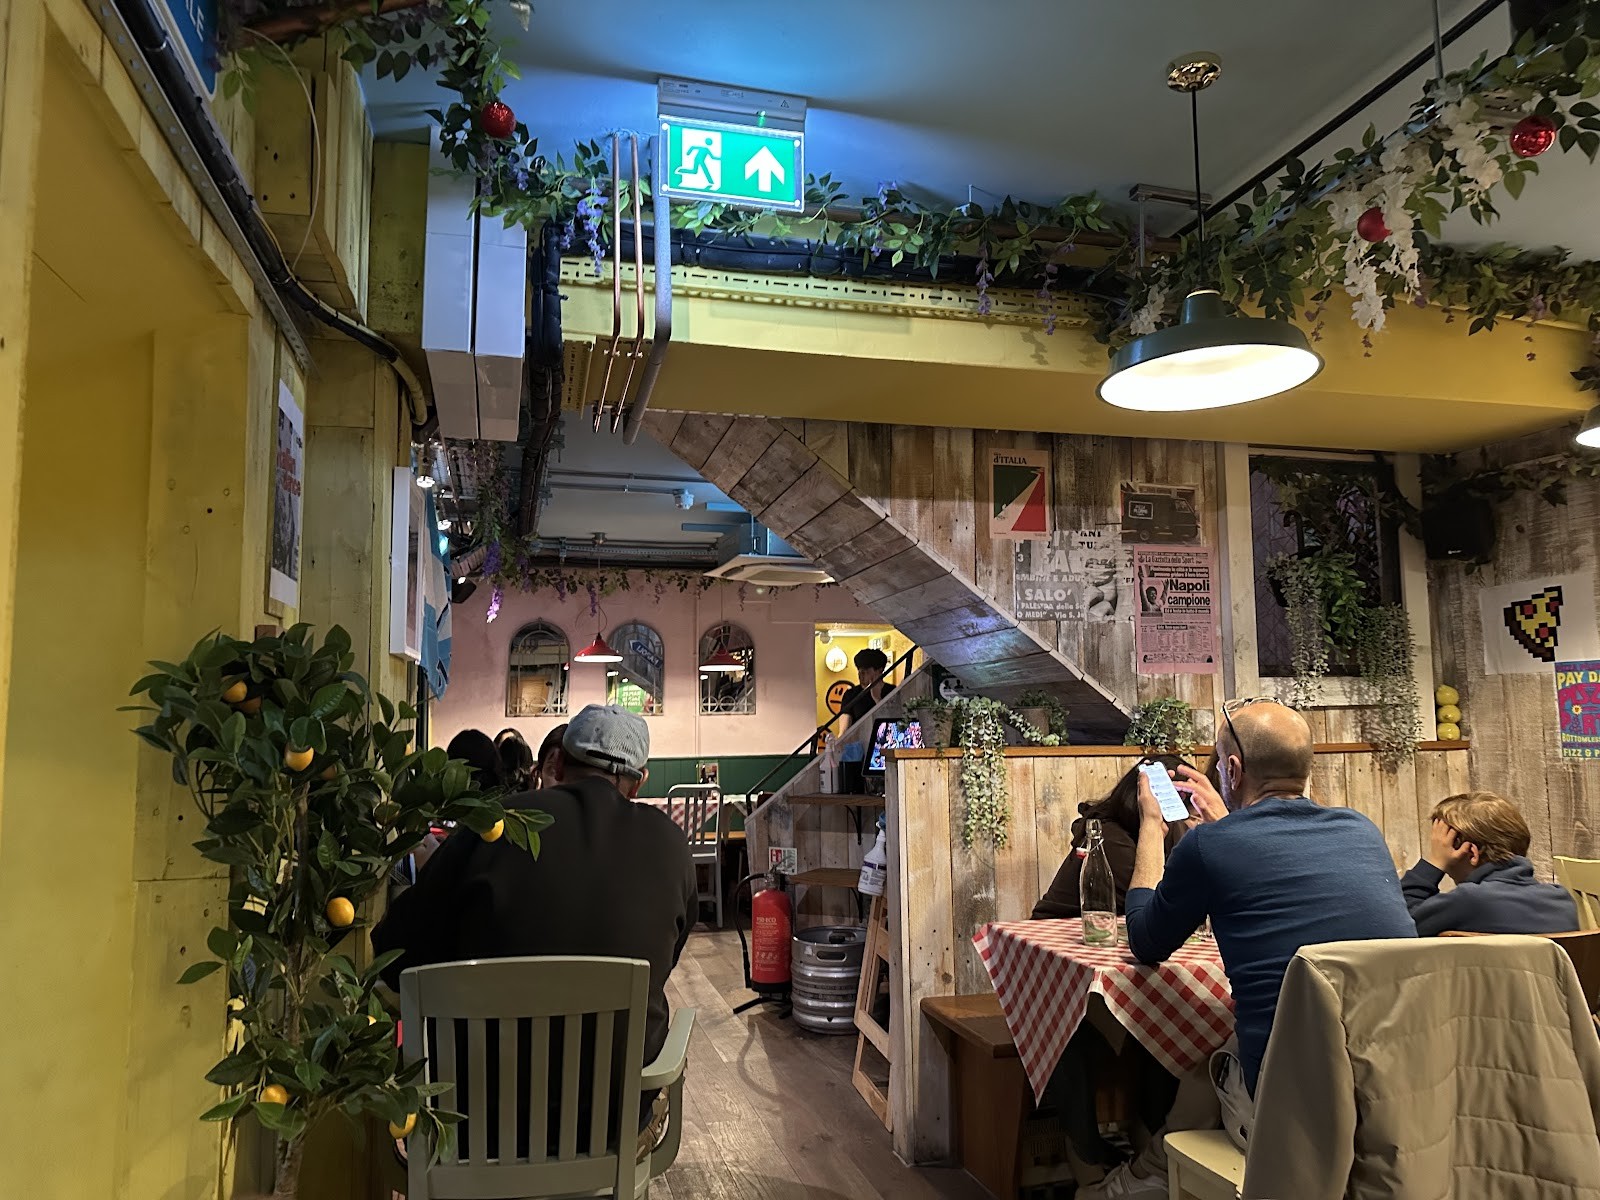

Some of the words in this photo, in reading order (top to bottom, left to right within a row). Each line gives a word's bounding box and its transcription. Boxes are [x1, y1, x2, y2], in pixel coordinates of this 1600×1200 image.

[186, 0, 204, 42] LE
[994, 454, 1027, 465] d'ITALIA
[1017, 554, 1024, 563] 3
[1169, 579, 1210, 593] Napoli
[1024, 588, 1071, 601] SALO'
[1167, 593, 1210, 607] campione
[1557, 671, 1584, 690] PAY
[1588, 671, 1600, 683] D
[1563, 748, 1582, 757] FIZZ
